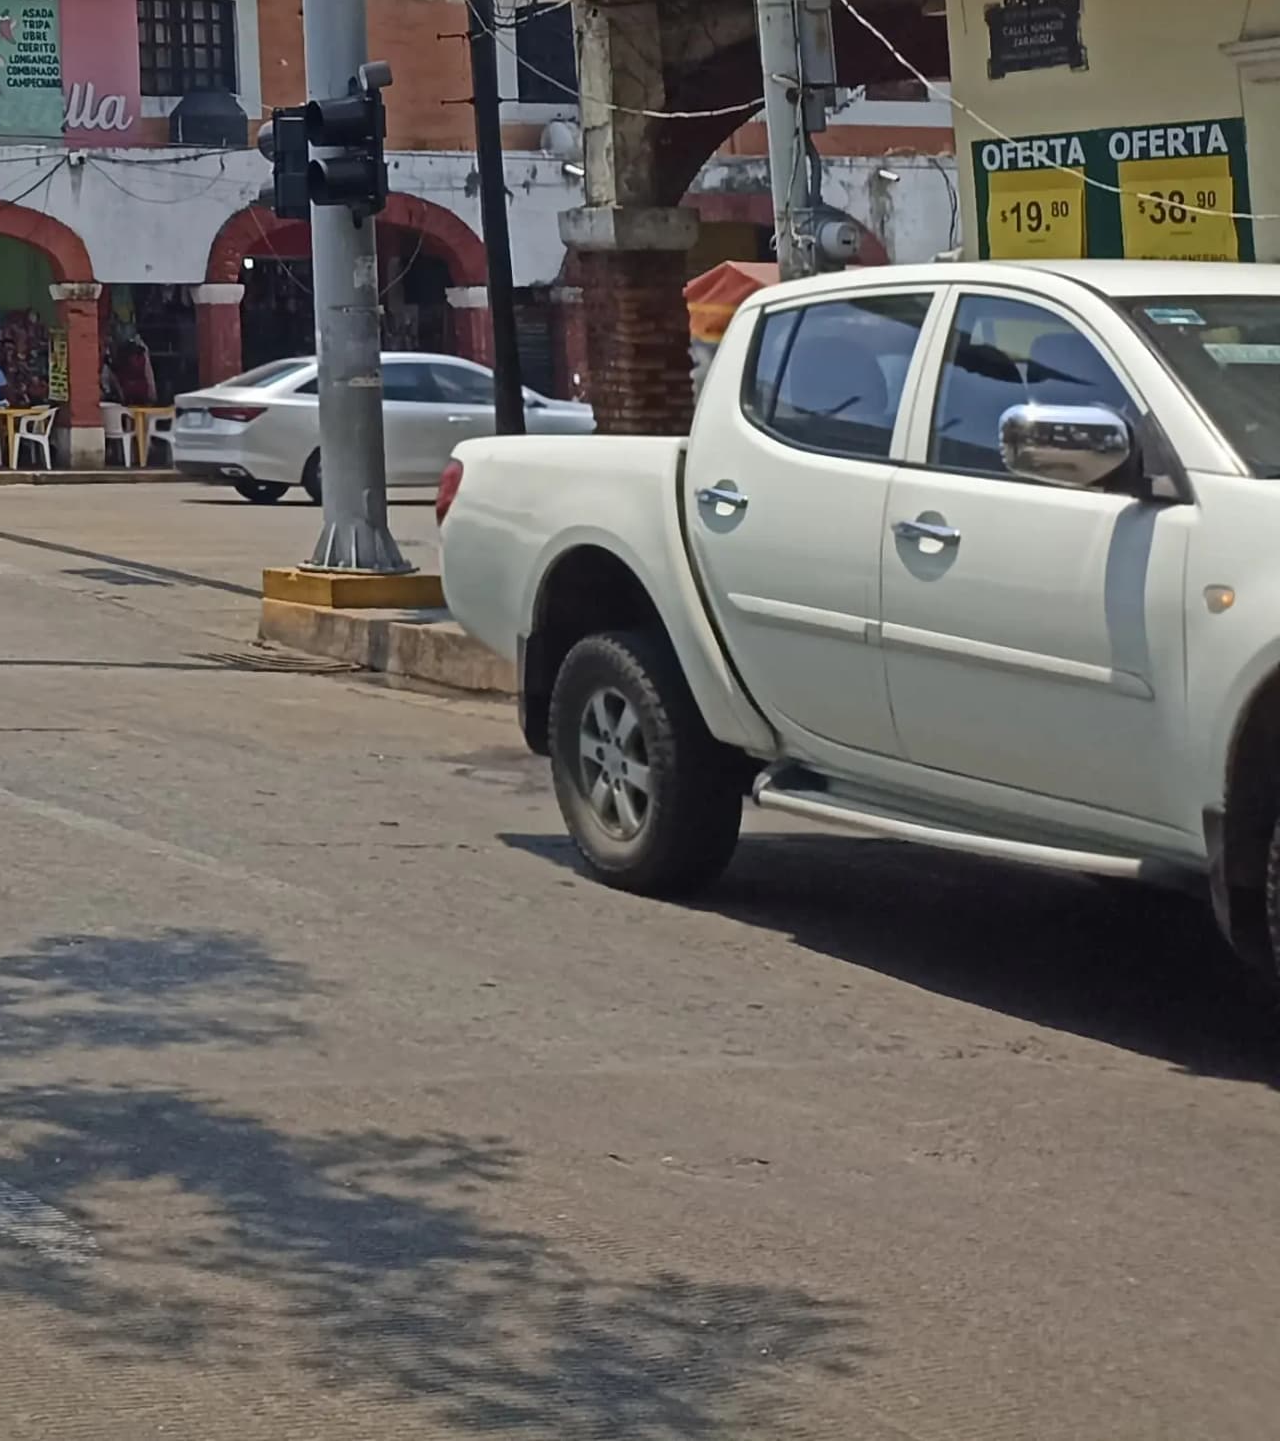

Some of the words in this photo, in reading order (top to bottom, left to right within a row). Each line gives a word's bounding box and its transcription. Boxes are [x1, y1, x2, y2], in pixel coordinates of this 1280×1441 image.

[22, 9, 54, 19] ASADA
[23, 20, 50, 30] TRIPA
[23, 31, 48, 41] UBRE
[17, 43, 56, 53] CUERITO
[9, 54, 60, 65] LONGANIZA
[7, 66, 59, 77] COMBINADO
[981, 137, 1087, 171] OFERTA
[1108, 124, 1228, 161] OFERTA
